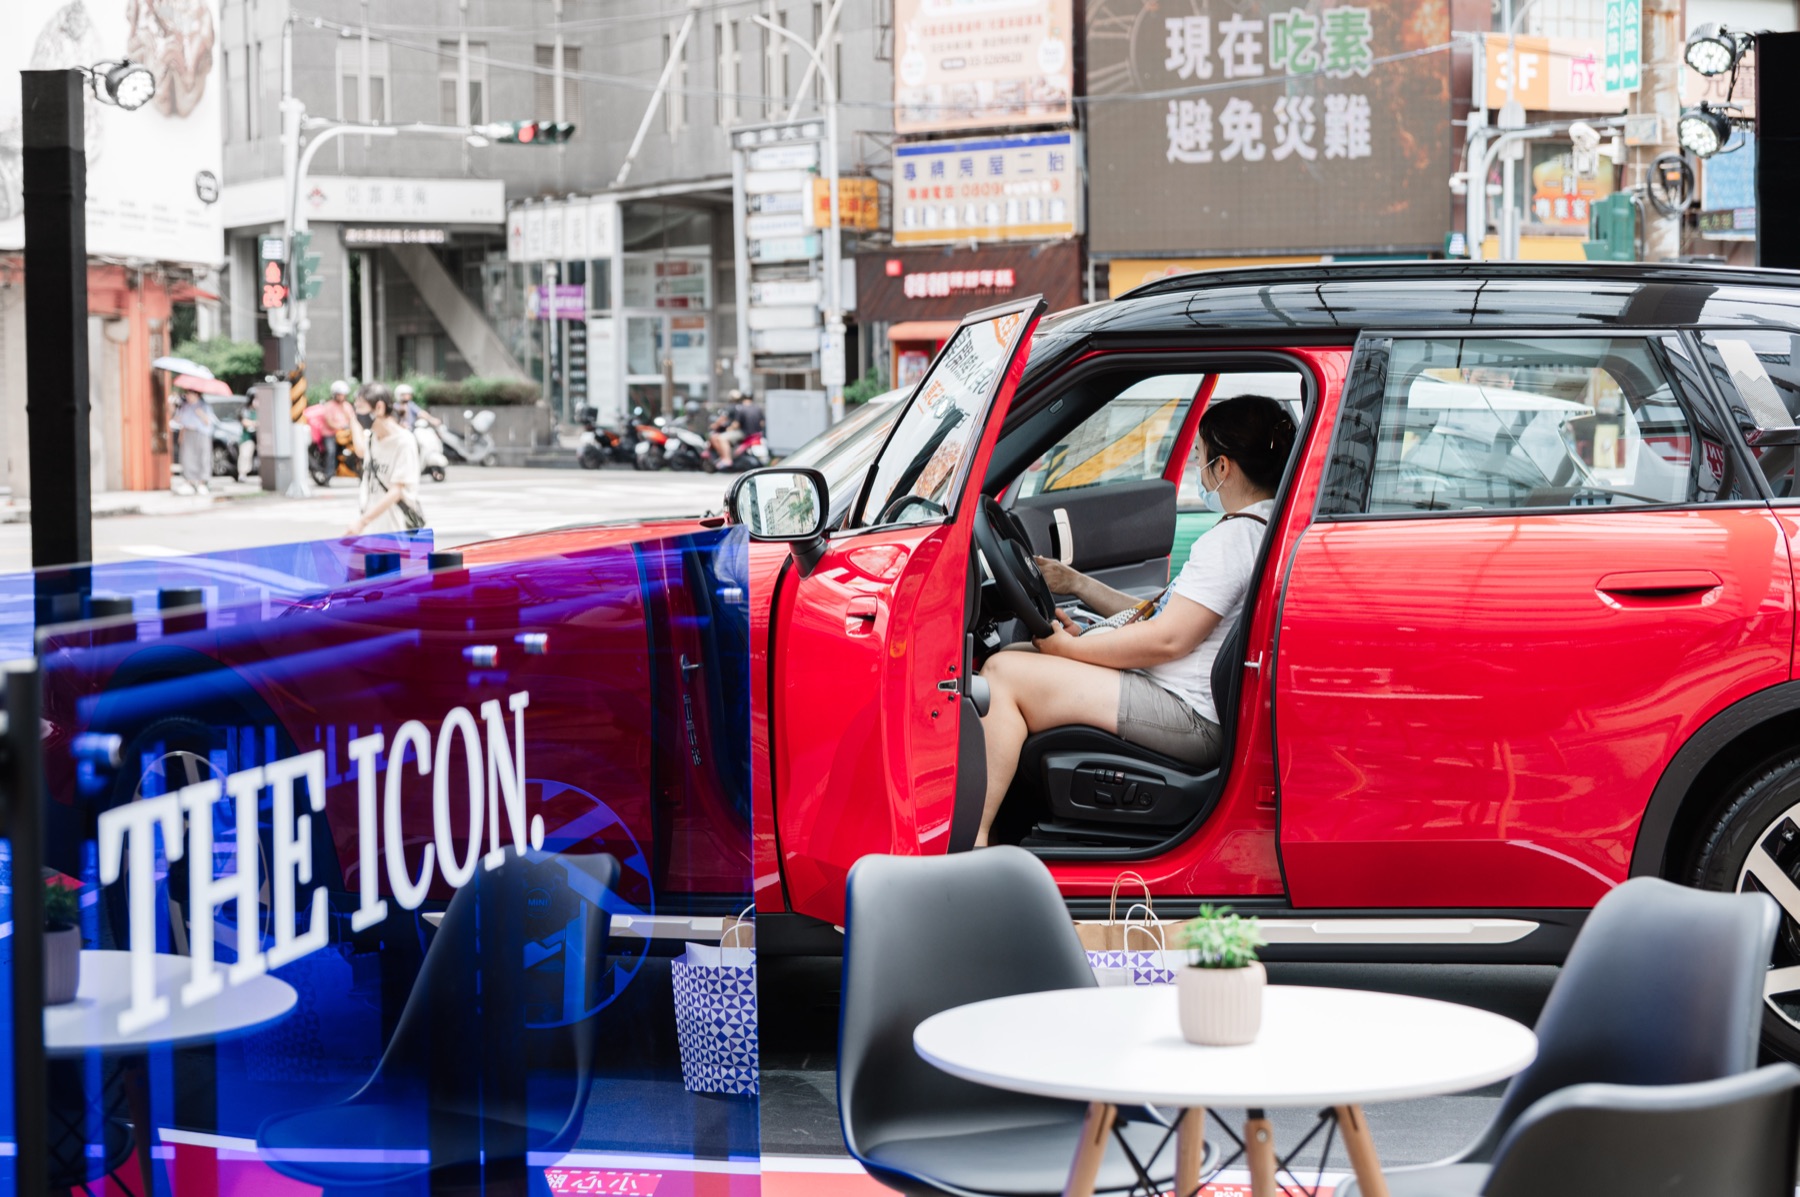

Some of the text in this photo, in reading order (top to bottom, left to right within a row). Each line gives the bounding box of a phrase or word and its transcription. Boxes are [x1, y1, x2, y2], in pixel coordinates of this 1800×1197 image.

[1164, 6, 1374, 80] 現在吃素
[1165, 94, 1372, 164] 避免災難
[98, 690, 545, 1036] THE ICON.
[527, 898, 549, 907] MINI
